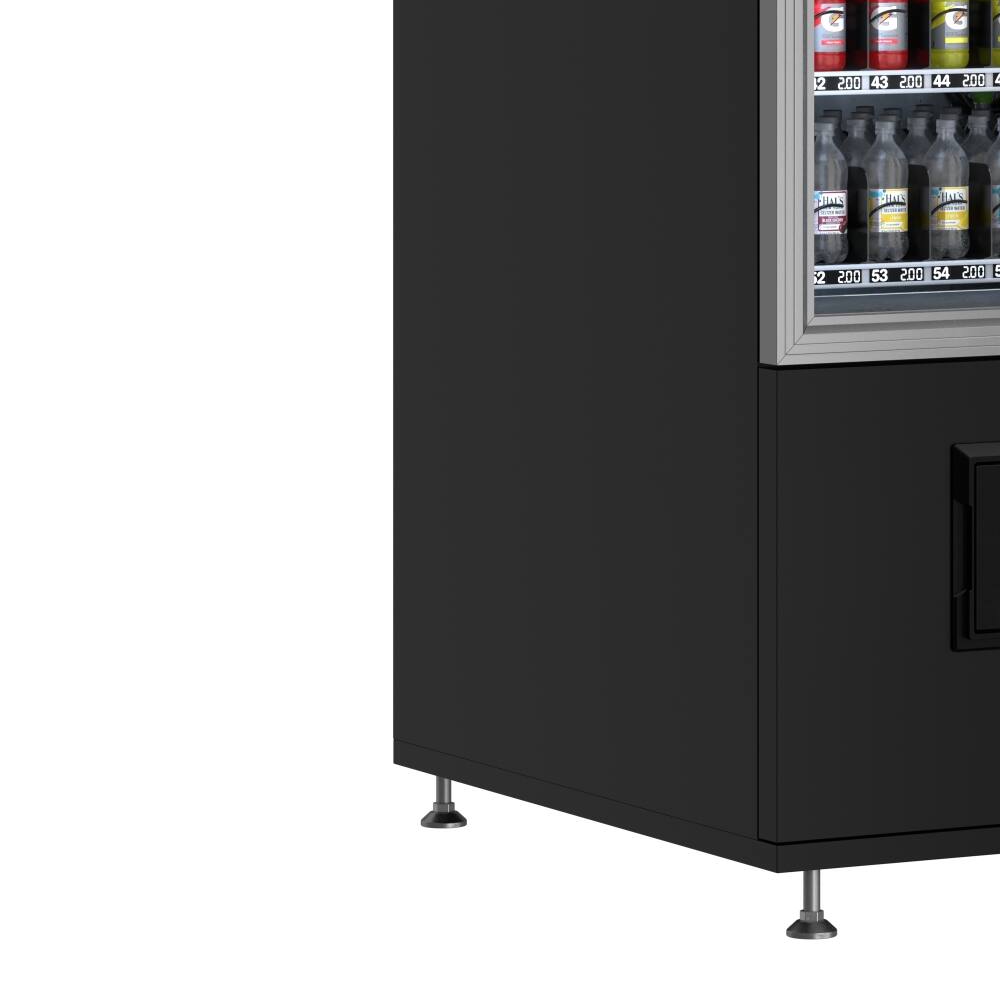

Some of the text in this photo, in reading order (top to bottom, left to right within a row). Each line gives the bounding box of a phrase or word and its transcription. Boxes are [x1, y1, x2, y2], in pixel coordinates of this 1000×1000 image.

[871, 76, 888, 89] 43
[933, 75, 950, 87] 44
[871, 269, 888, 282] 53
[933, 267, 950, 279] 54
